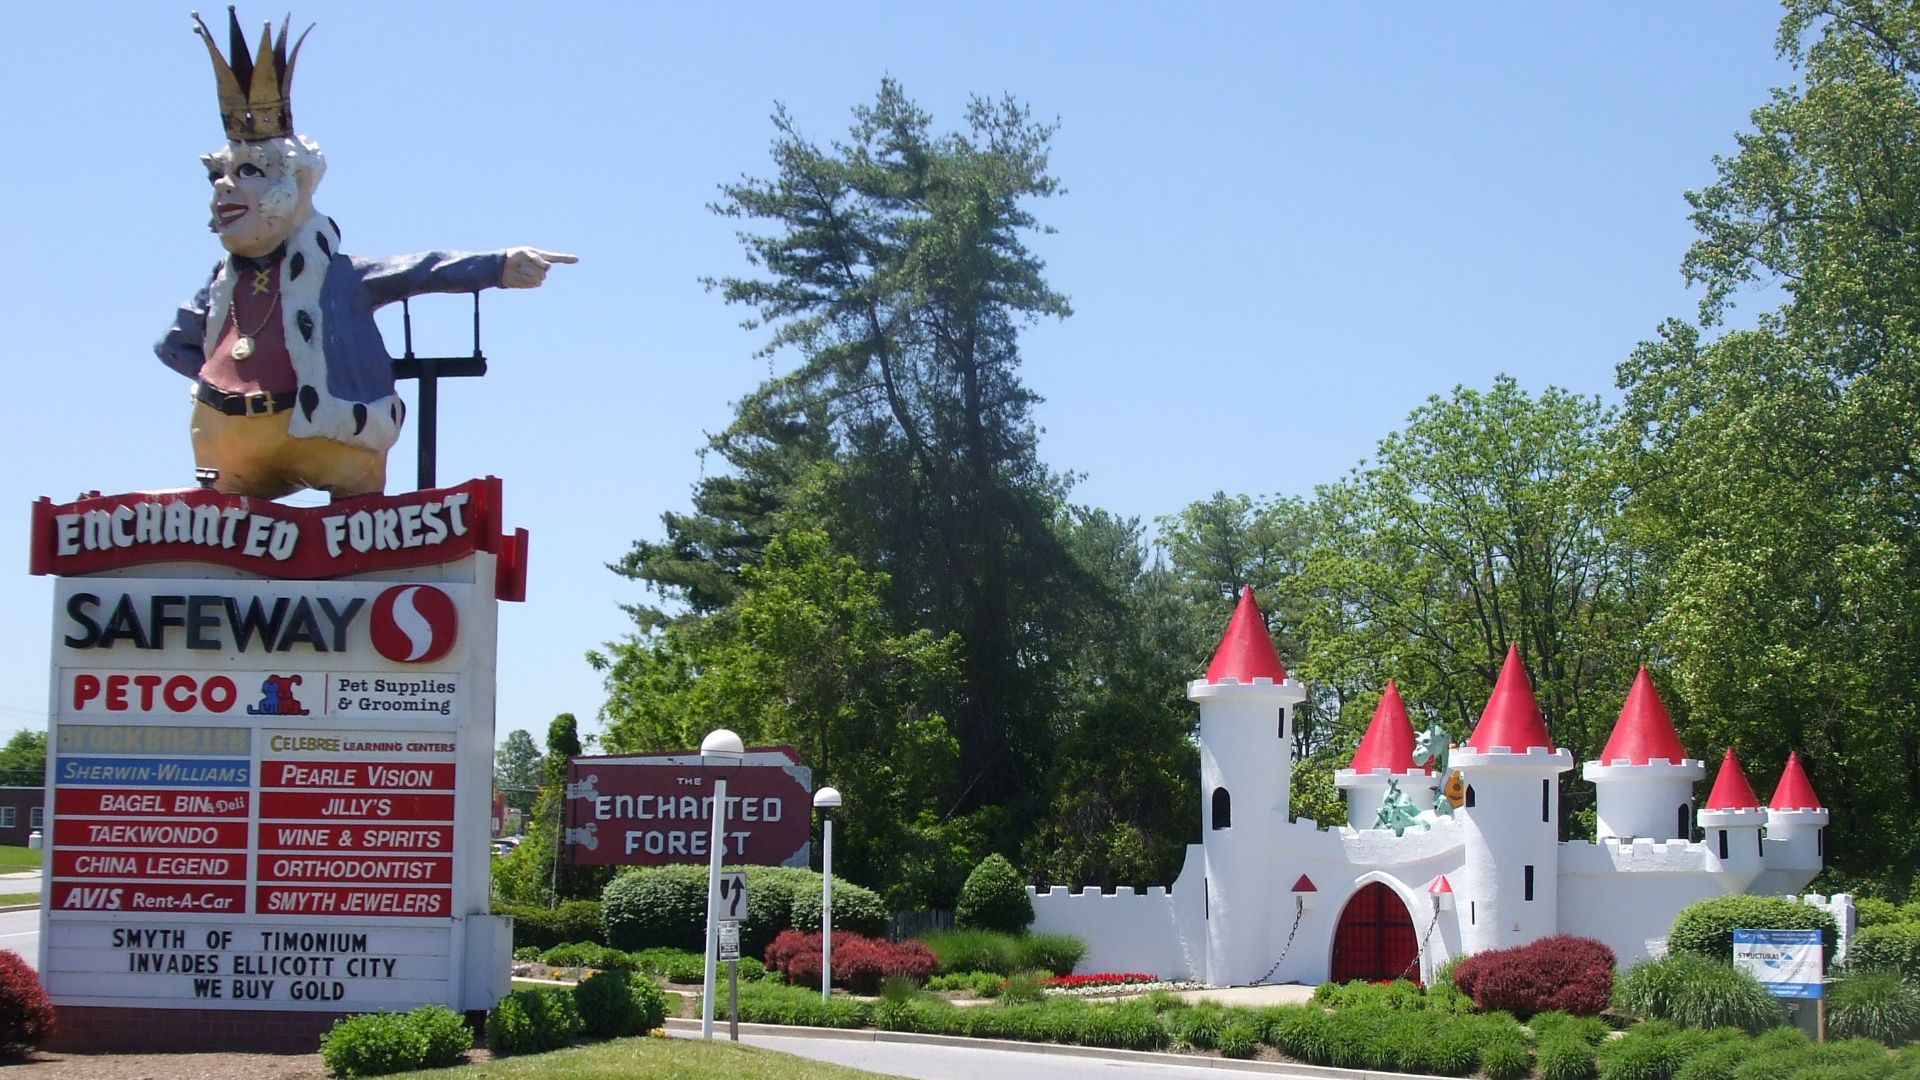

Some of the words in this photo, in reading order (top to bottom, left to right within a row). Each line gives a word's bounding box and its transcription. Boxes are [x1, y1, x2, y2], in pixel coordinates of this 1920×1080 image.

[56, 499, 299, 561] ENCHANTED
[322, 492, 469, 558] FOREST
[64, 592, 367, 653] SAFEWAY
[73, 674, 237, 713] PETCO
[338, 679, 368, 692] Pet
[374, 679, 456, 696] Supplies
[338, 698, 352, 710] &
[358, 697, 451, 715] Grooming
[270, 735, 340, 752] CELEBREE
[343, 742, 402, 751] LEARNING
[407, 743, 456, 752] CENTERS
[63, 762, 248, 782] SHERWIN-WILLIAMS
[281, 765, 357, 786] PEARLE
[367, 765, 434, 787] VISION
[676, 777, 703, 786] THE
[99, 794, 166, 812] BAGEL
[173, 796, 211, 813] BIN
[215, 796, 246, 812] Deli
[321, 798, 392, 816] JILLY'S
[595, 795, 782, 822] ENCHANTED
[88, 825, 218, 844] TAEKWONDO
[277, 829, 330, 846] WINE
[338, 830, 352, 847] &
[362, 830, 441, 848] SPIRITS
[75, 856, 137, 874] CHINA
[145, 857, 229, 876] LEGEND
[273, 859, 436, 879] ORTHODONTIST
[63, 887, 123, 910] AVIS
[132, 892, 233, 910] Rent-A-Car
[267, 891, 337, 911] SMYTH
[340, 893, 441, 913] JEWELERS
[112, 928, 185, 949] SMYTH
[206, 930, 233, 950] OF
[261, 932, 367, 953] TIMONIUM
[129, 953, 219, 974] INVADES
[233, 955, 334, 976] ELLICOTT
[346, 957, 397, 978] CITY
[193, 978, 222, 998] WE
[232, 979, 274, 999] BUY
[290, 981, 345, 1001] GOLD
